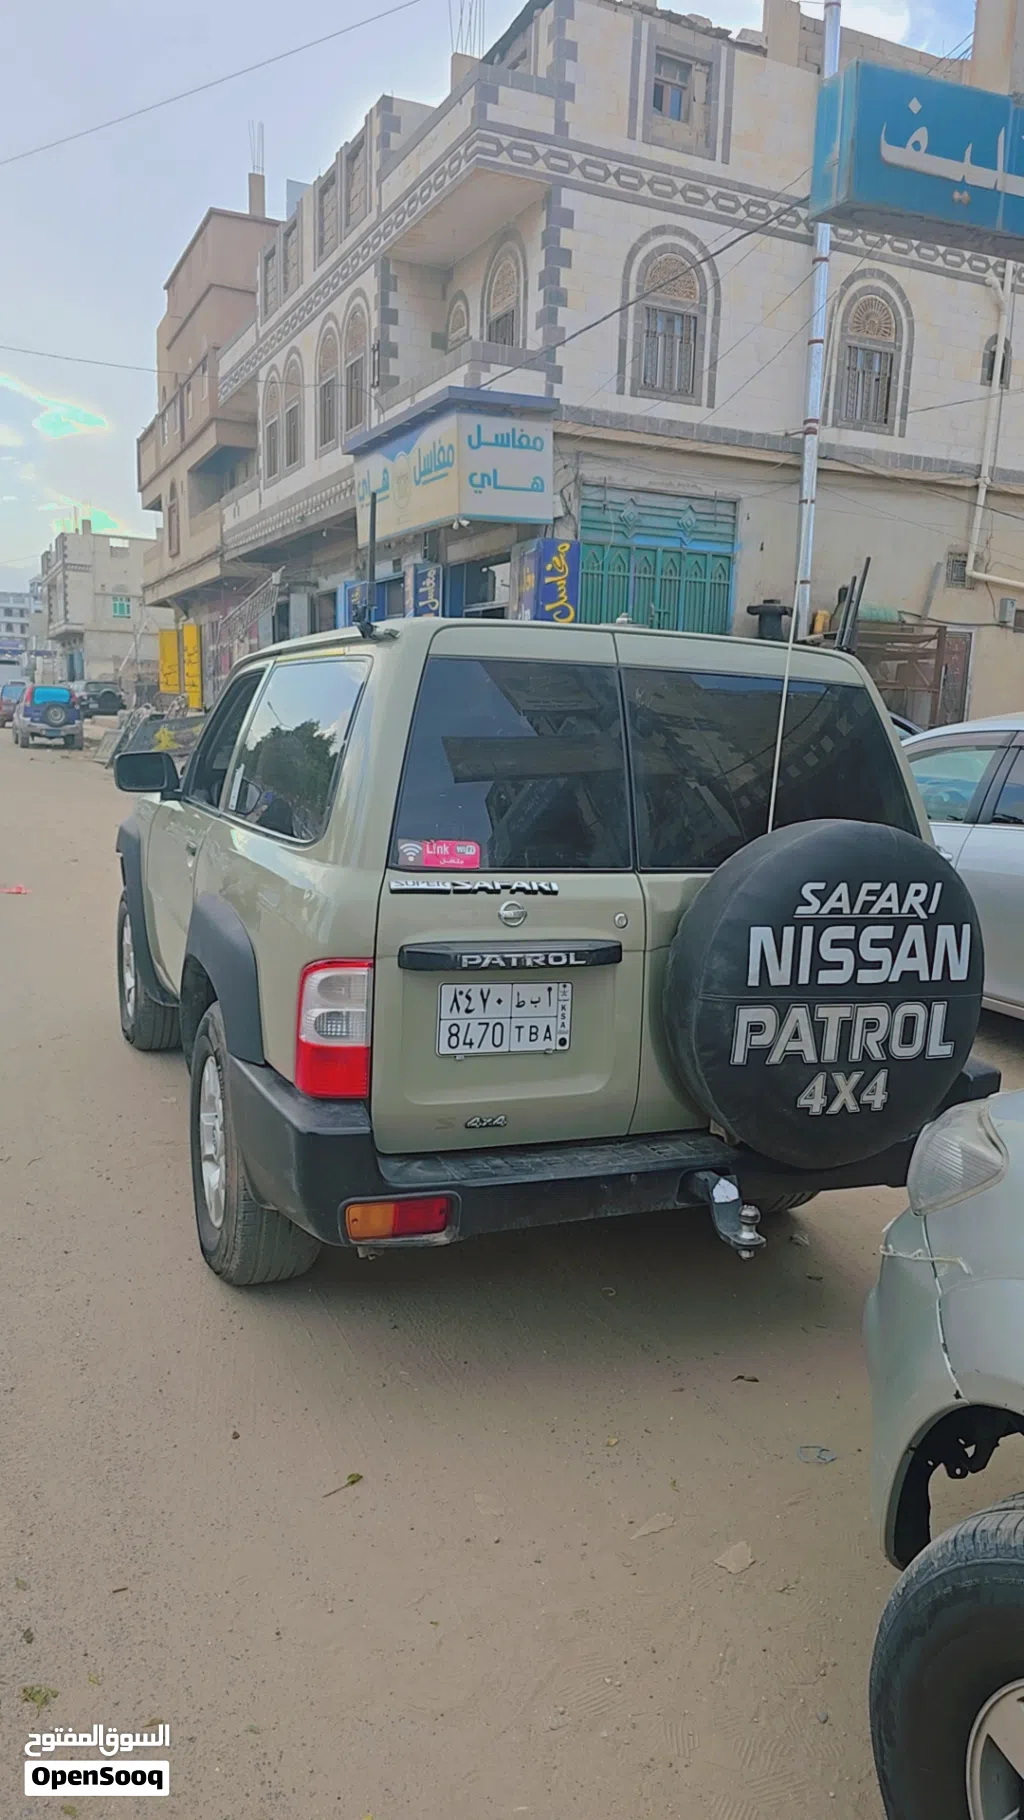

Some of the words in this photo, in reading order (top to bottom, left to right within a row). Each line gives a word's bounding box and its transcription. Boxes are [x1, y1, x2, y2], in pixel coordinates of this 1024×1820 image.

[880, 96, 1024, 206] ليف
[468, 468, 545, 494] هاي
[426, 842, 449, 855] Link
[390, 879, 450, 893] SUPER
[452, 880, 559, 895] SAFARI
[794, 881, 943, 919] SAFARI
[461, 951, 588, 968] PATROL
[747, 923, 971, 987] NISSAN
[449, 987, 504, 1014] ٨٤٧٠
[447, 1022, 504, 1049] 8470
[730, 1001, 955, 1066] PATROL
[796, 1069, 889, 1115] 4X4
